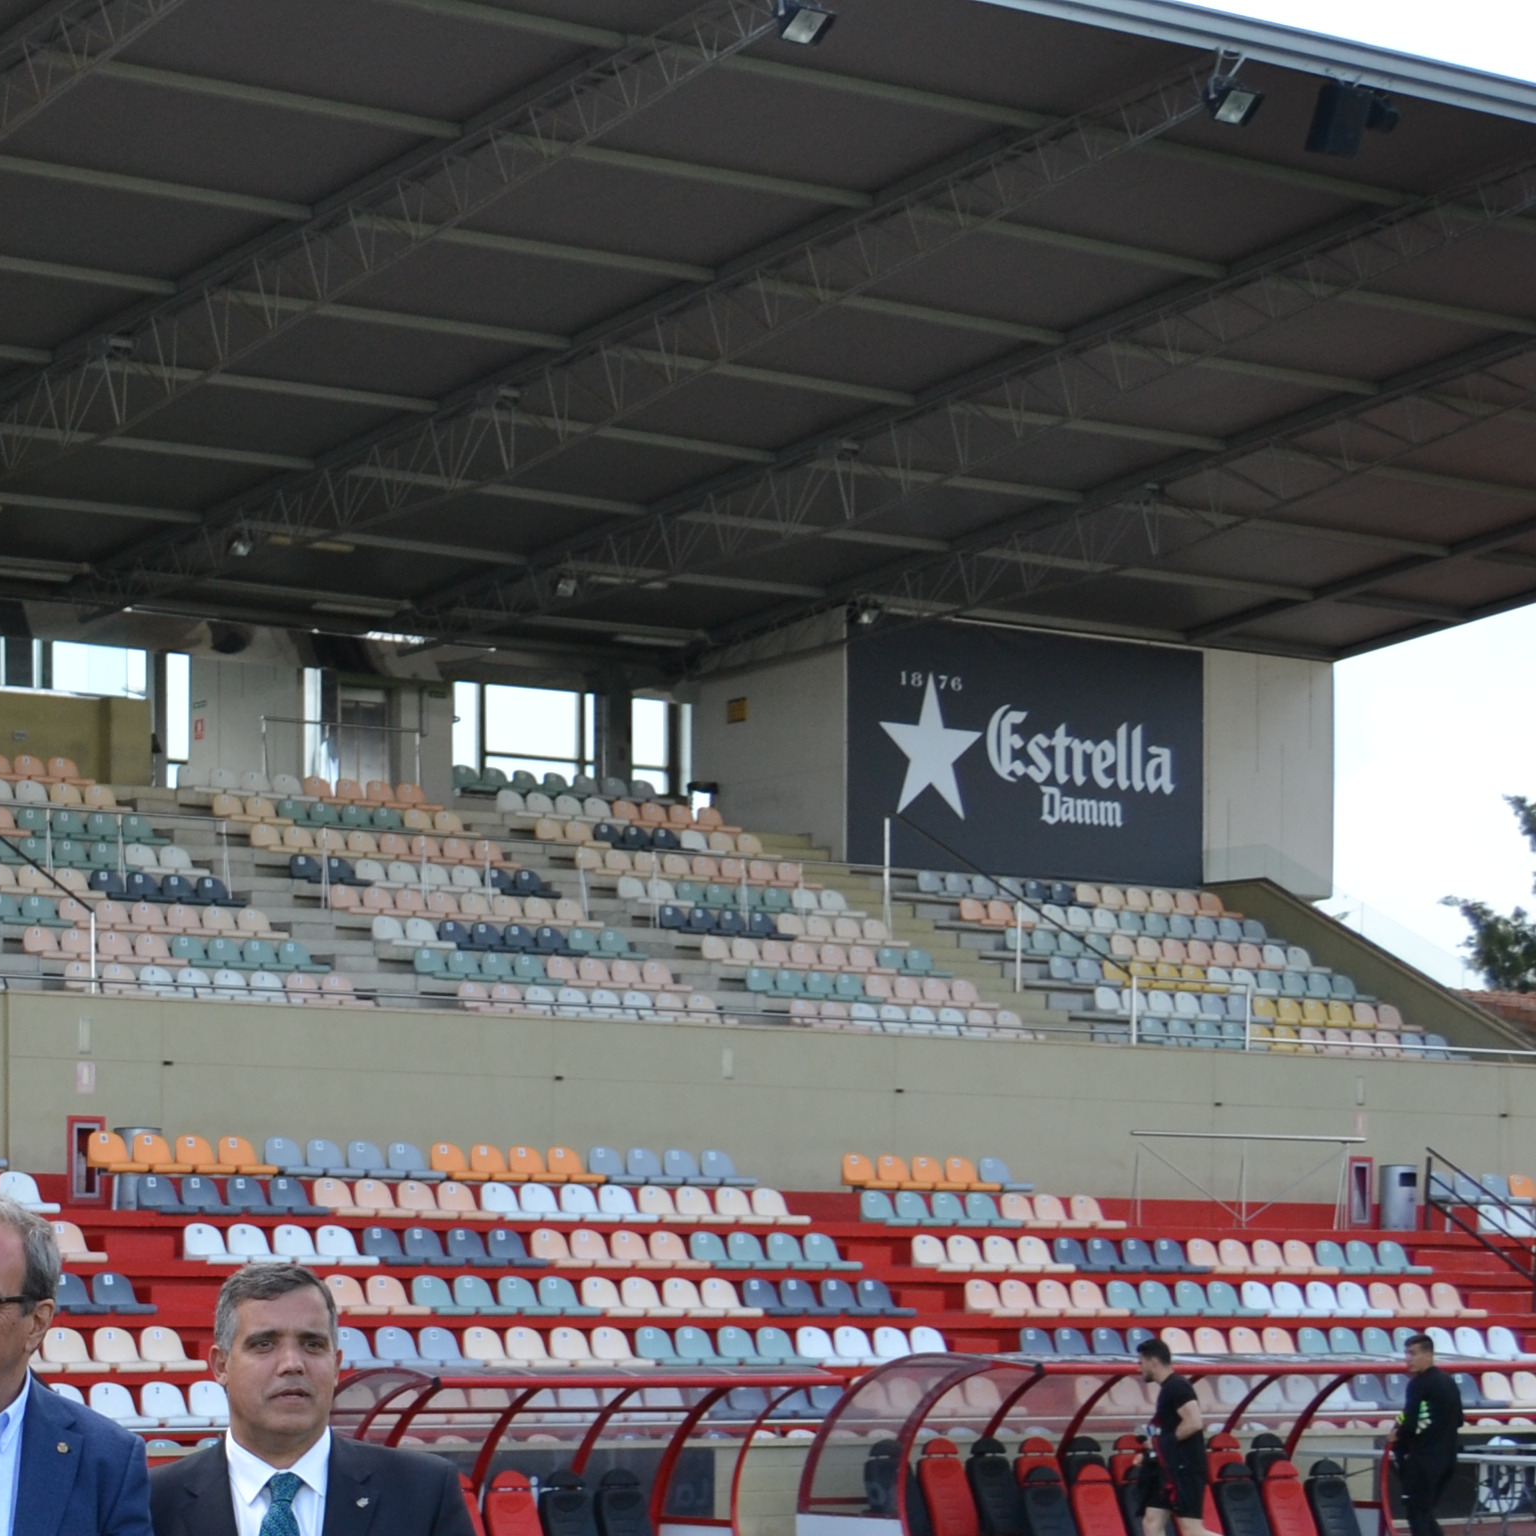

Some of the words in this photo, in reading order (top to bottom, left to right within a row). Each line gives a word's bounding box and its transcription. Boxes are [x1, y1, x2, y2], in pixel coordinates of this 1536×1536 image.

[899, 670, 924, 688] 18
[937, 674, 963, 692] 76
[986, 703, 1177, 796] Estrella
[1039, 784, 1124, 828] Damm
